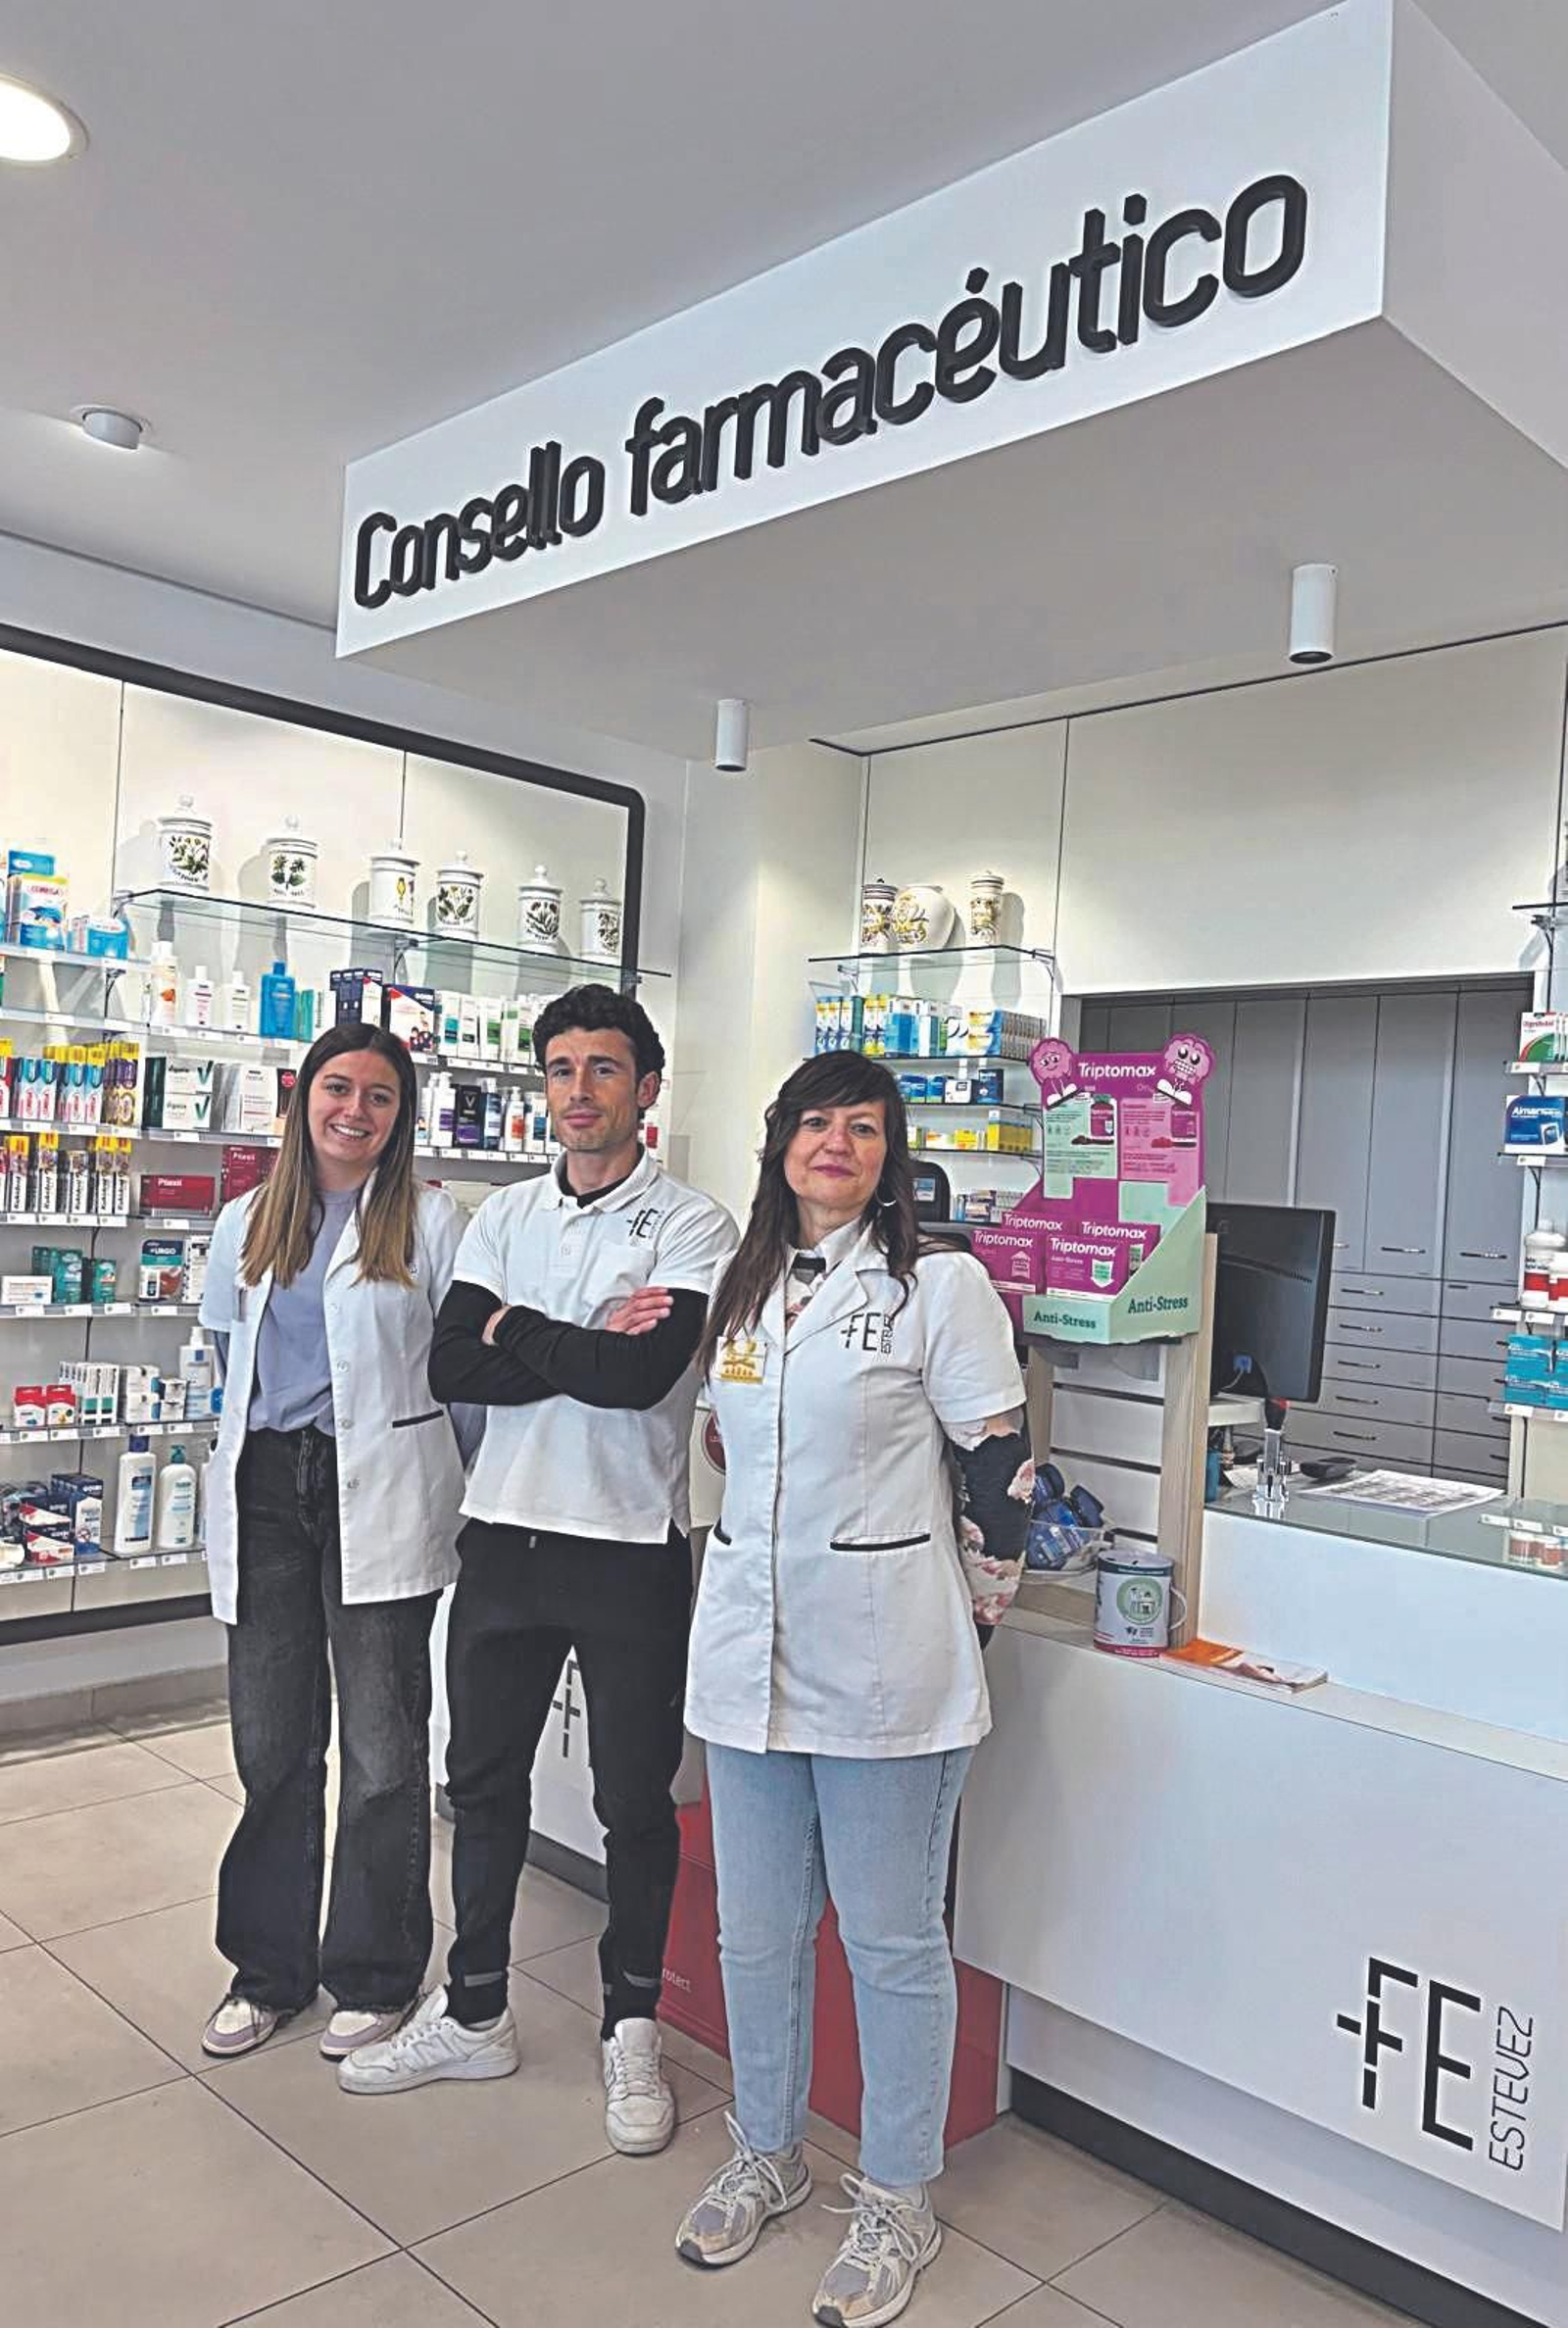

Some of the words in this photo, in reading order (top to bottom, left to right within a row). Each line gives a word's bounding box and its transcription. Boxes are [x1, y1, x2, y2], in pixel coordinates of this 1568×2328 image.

[354, 440, 606, 610] Consello
[625, 173, 1308, 516] farmacéutico
[1079, 1063, 1157, 1080] Triptomax
[1004, 1213, 1063, 1231] Triptomax
[1081, 1221, 1148, 1239] Triptomax
[973, 1230, 1033, 1248] Triptomax
[1051, 1237, 1116, 1257] Triptomax
[1127, 1295, 1188, 1314] Anti-Stress
[1033, 1311, 1097, 1329] Anti-Stress
[1489, 2006, 1533, 2171] ESTEVEZ
